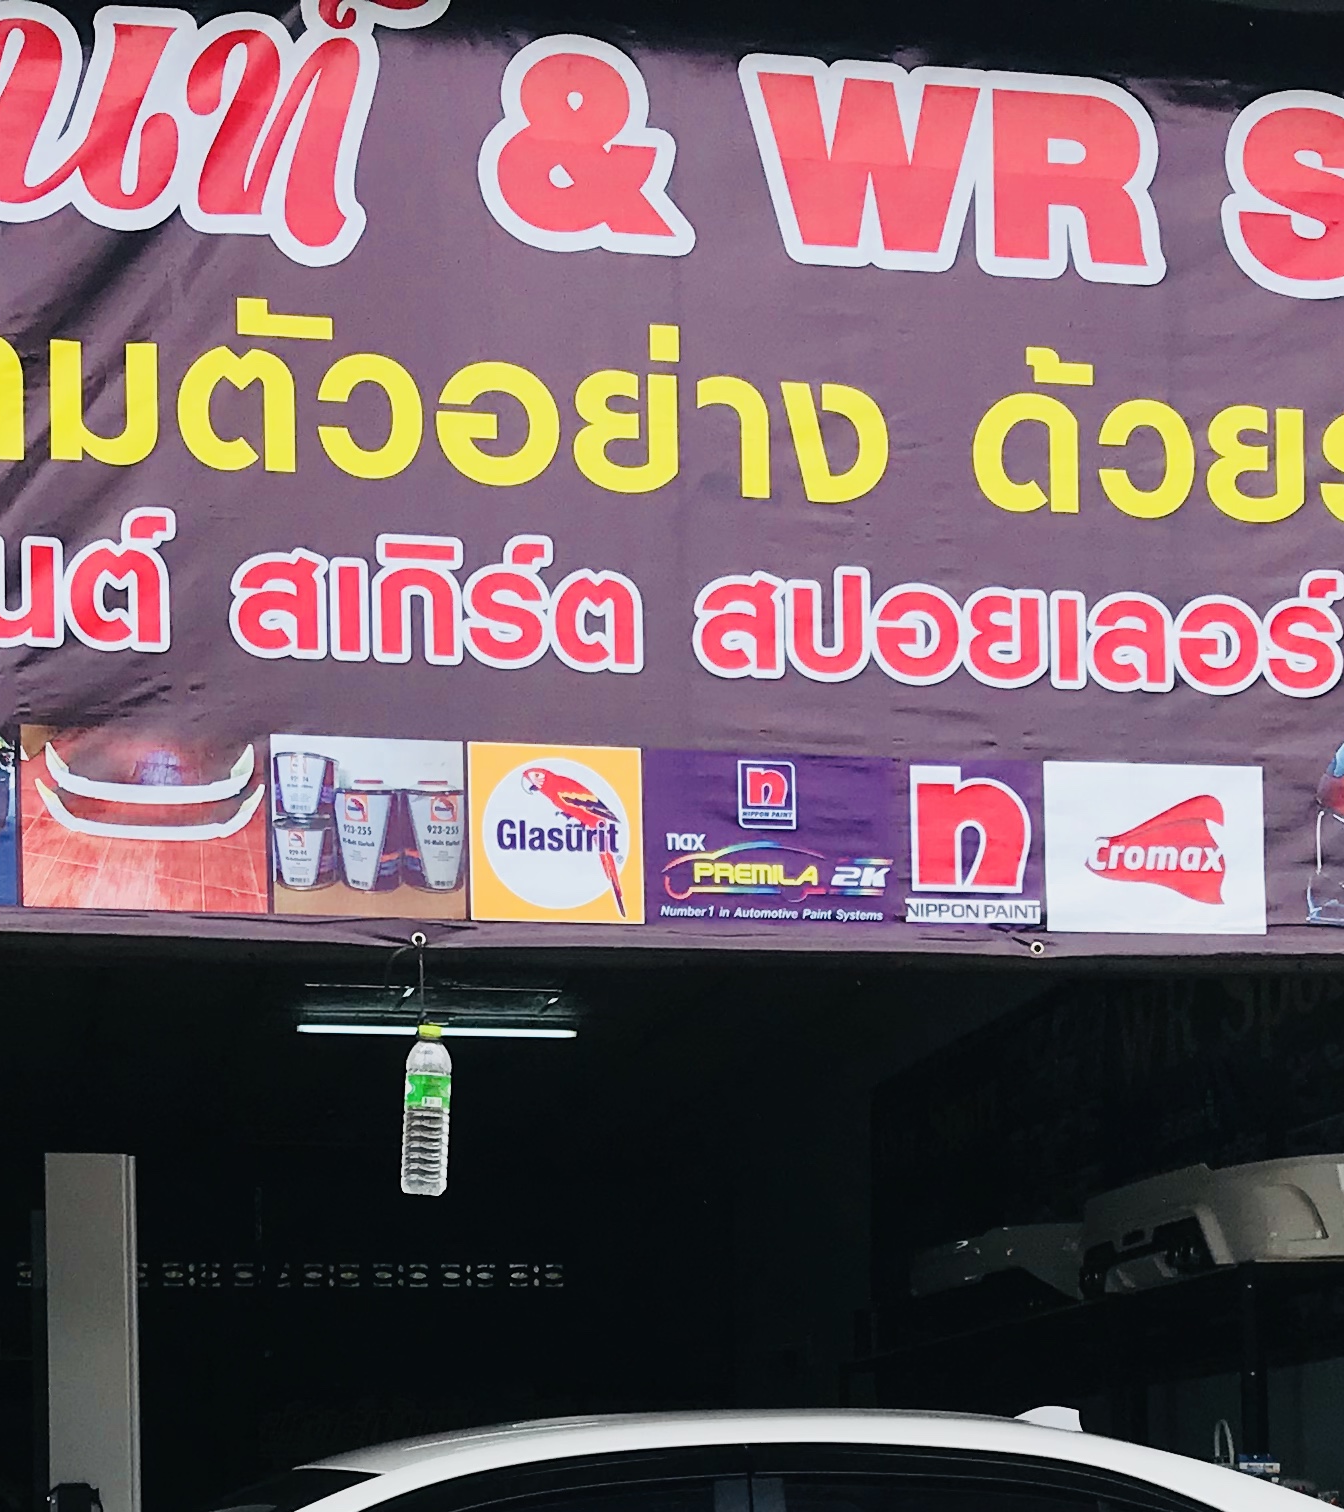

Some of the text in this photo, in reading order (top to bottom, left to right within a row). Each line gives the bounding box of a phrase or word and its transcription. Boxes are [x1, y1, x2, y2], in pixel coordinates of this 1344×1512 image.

[478, 34, 697, 256] &
[738, 53, 1166, 286] WR
[229, 534, 644, 673] สเกิร์ต
[666, 833, 706, 851] nax
[1088, 839, 1223, 872] Cromax
[693, 862, 891, 887] PREMILA 2K
[719, 907, 730, 918] in
[734, 907, 798, 919] Automotive
[802, 908, 832, 920] Paint
[835, 908, 884, 922] Systems
[906, 902, 1041, 919] NIPPON PAINT
